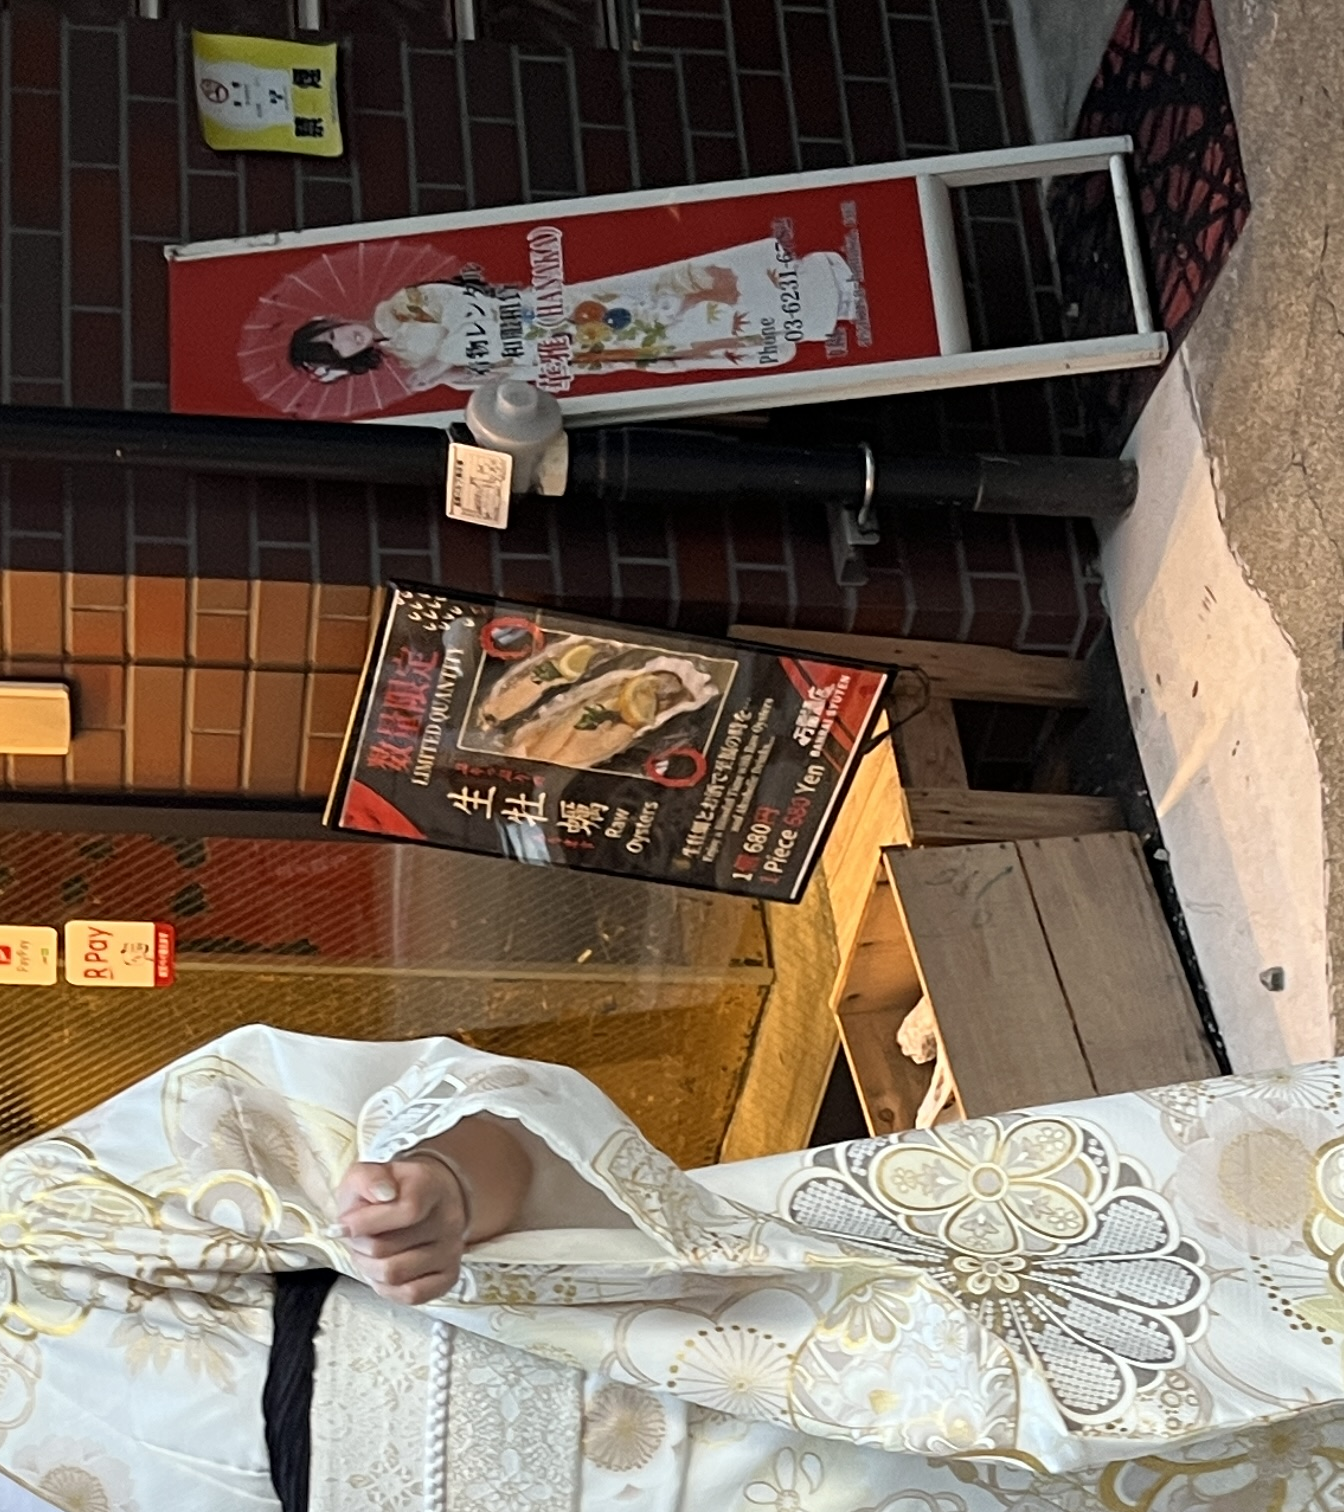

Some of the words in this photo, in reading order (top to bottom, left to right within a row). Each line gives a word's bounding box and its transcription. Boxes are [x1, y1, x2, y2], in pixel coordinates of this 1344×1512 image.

[758, 317, 778, 364] Phone
[366, 646, 439, 771] 数量限定
[411, 724, 442, 786] LIMITED
[428, 646, 464, 723] QUANTITY
[794, 764, 825, 794] Yen
[447, 786, 610, 836] 生牡蠣
[604, 808, 629, 839] Raw
[626, 801, 659, 854] Oysters
[783, 796, 811, 827] 680
[763, 829, 798, 873] Piece
[15, 940, 31, 973] PayPay
[84, 926, 113, 963] Pay
